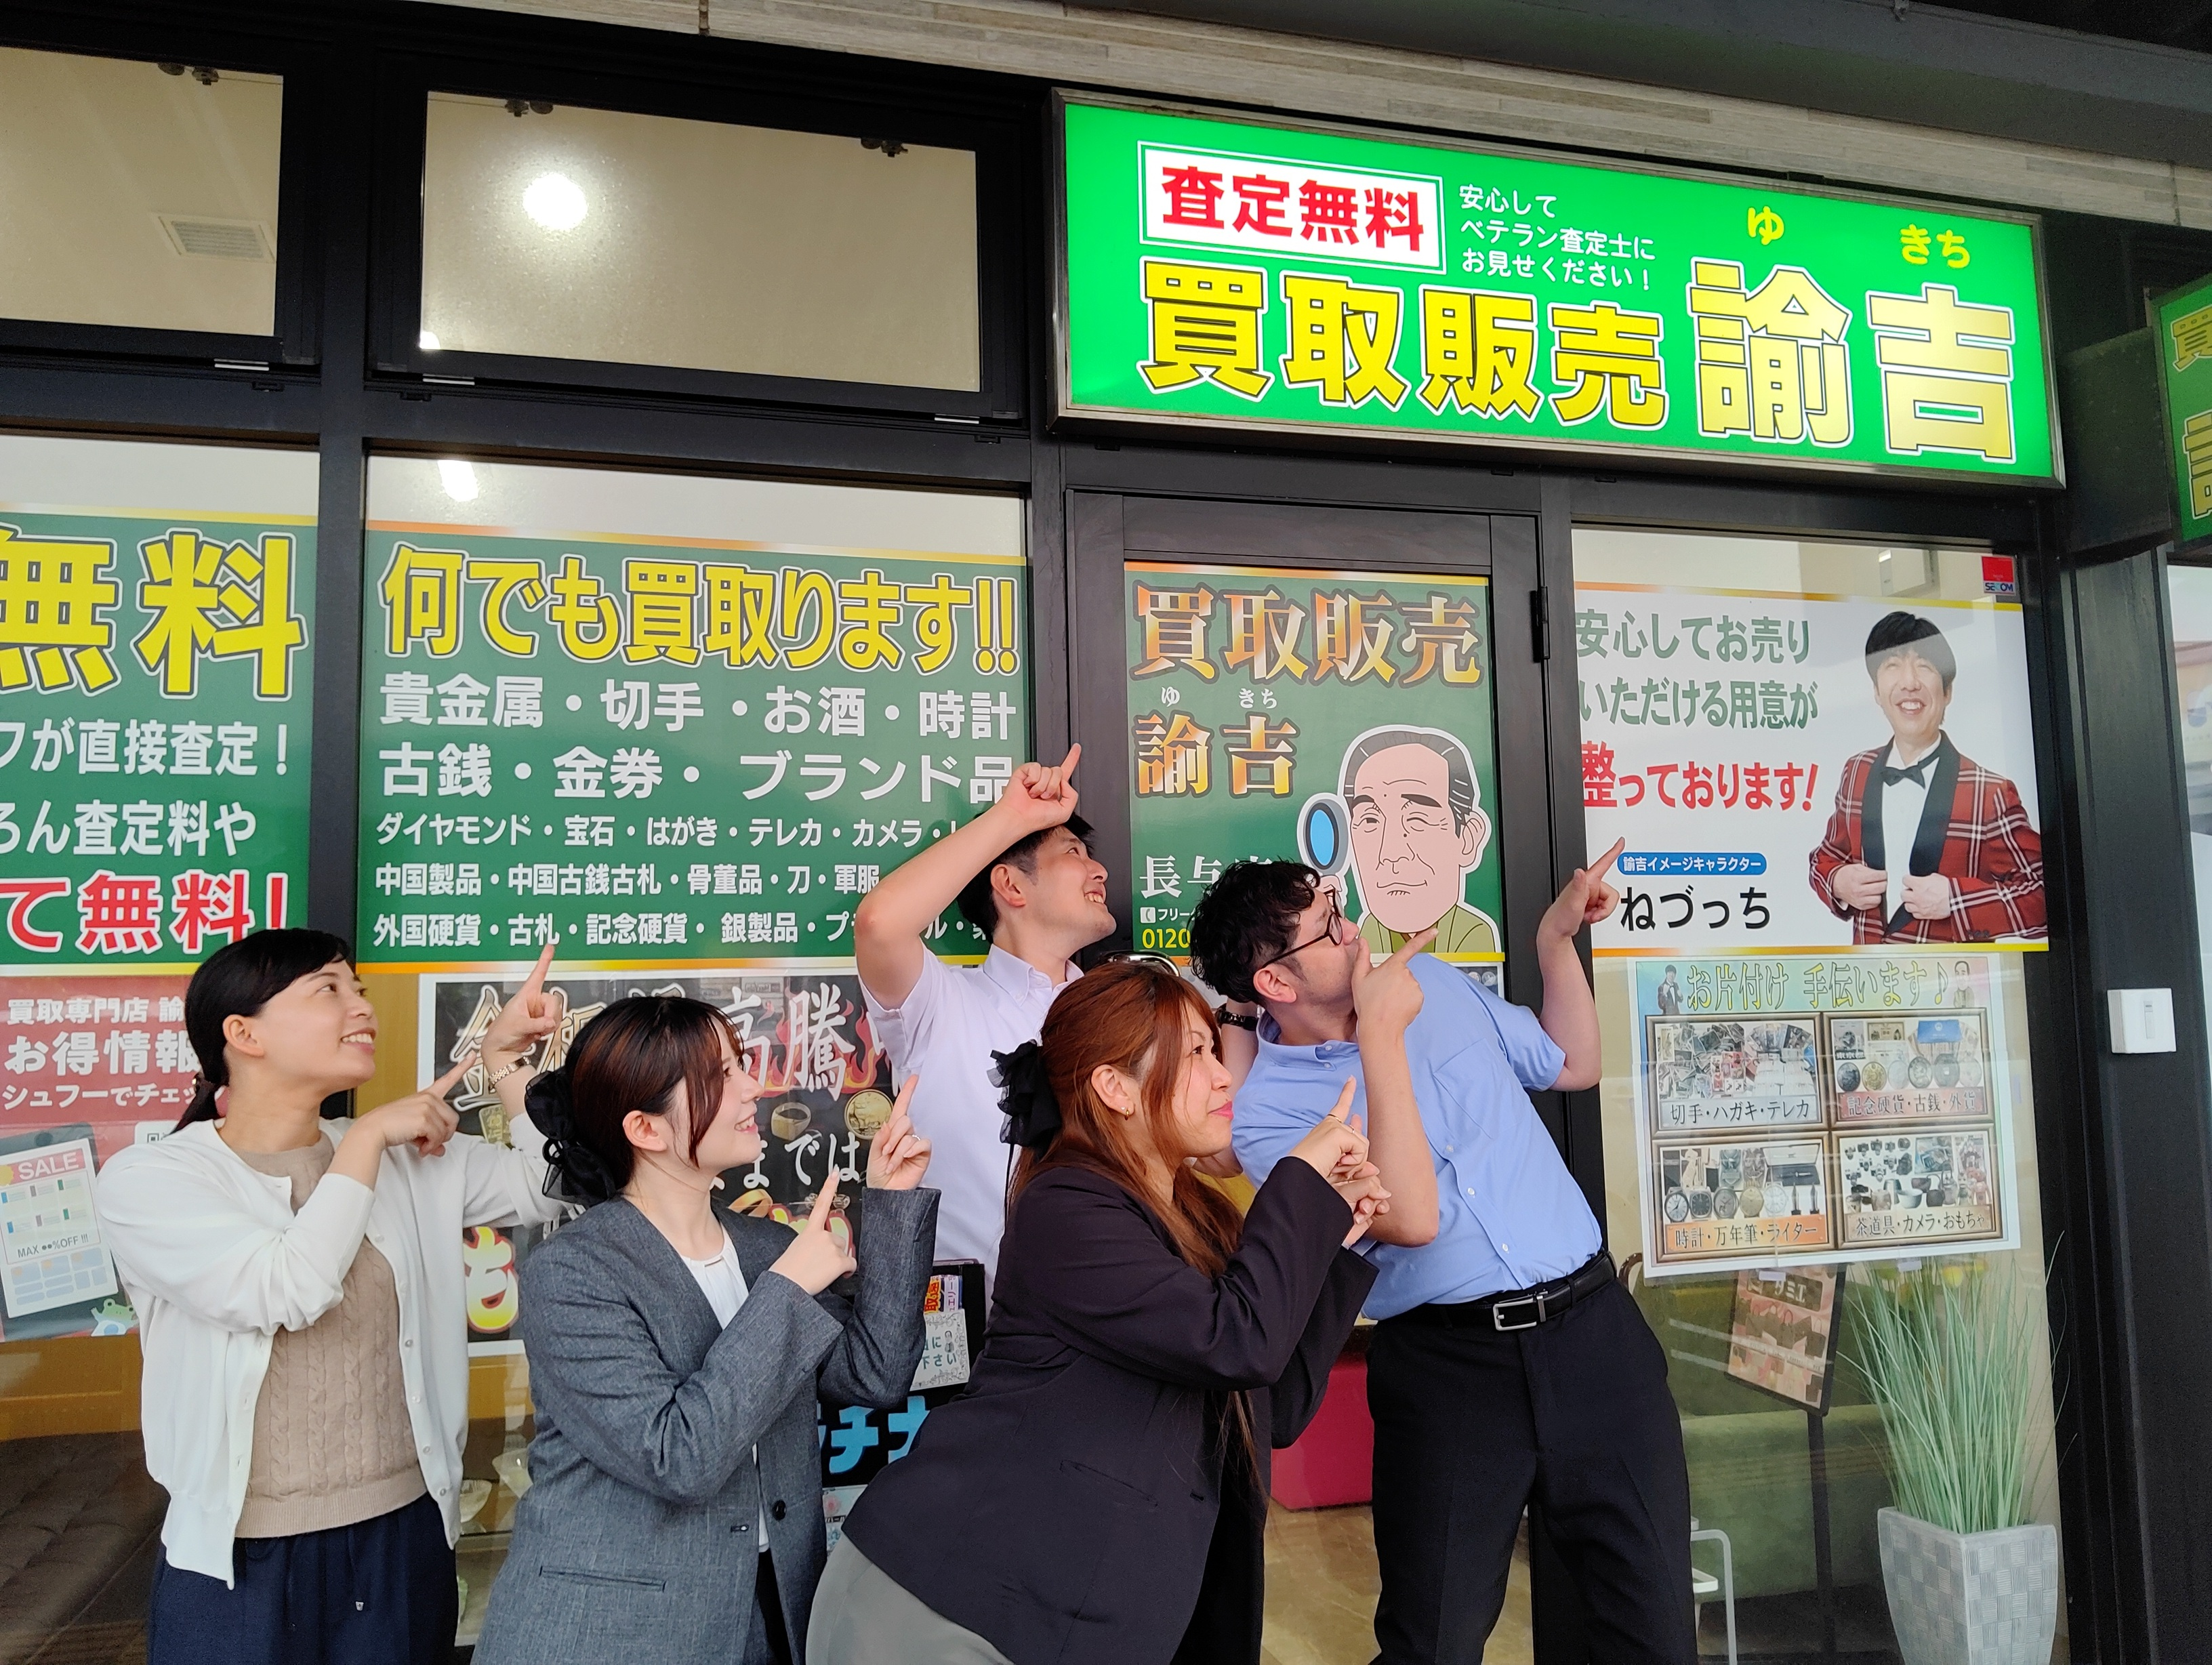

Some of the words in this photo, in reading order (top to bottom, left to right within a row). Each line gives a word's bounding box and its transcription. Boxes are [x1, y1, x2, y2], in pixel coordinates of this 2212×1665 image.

[1162, 165, 1424, 252] 査定無料
[1459, 184, 1557, 218] 安心して
[1460, 220, 1656, 259] ベテラン査定士に
[1747, 206, 1785, 246] ゆ
[1900, 224, 1971, 269] きち
[1462, 247, 1650, 291] お見せください！
[378, 541, 1020, 676] 何でも買取ります!!
[1985, 582, 2013, 592] SECOM
[0, 523, 308, 701] 無料
[1131, 581, 1483, 686] 買取販売
[1576, 609, 1809, 665] 安心してお売り
[1160, 686, 1181, 707] ゆ
[1238, 686, 1278, 710] きち
[1579, 676, 1818, 730] いただける用意が
[1134, 713, 1298, 796] 諭吉
[376, 812, 956, 848] ダイヤモンド・宝石・はがき・テレカ・カメラ・
[1622, 856, 1761, 871] 諭吉イメージキャラクター
[1620, 884, 1771, 932] ねづっち
[1687, 962, 1789, 1011] お片付け
[7, 997, 150, 1025] 買取専門店
[4, 1029, 202, 1076] お得情報
[18, 1153, 79, 1181] SALE
[18, 1244, 40, 1259] MAX
